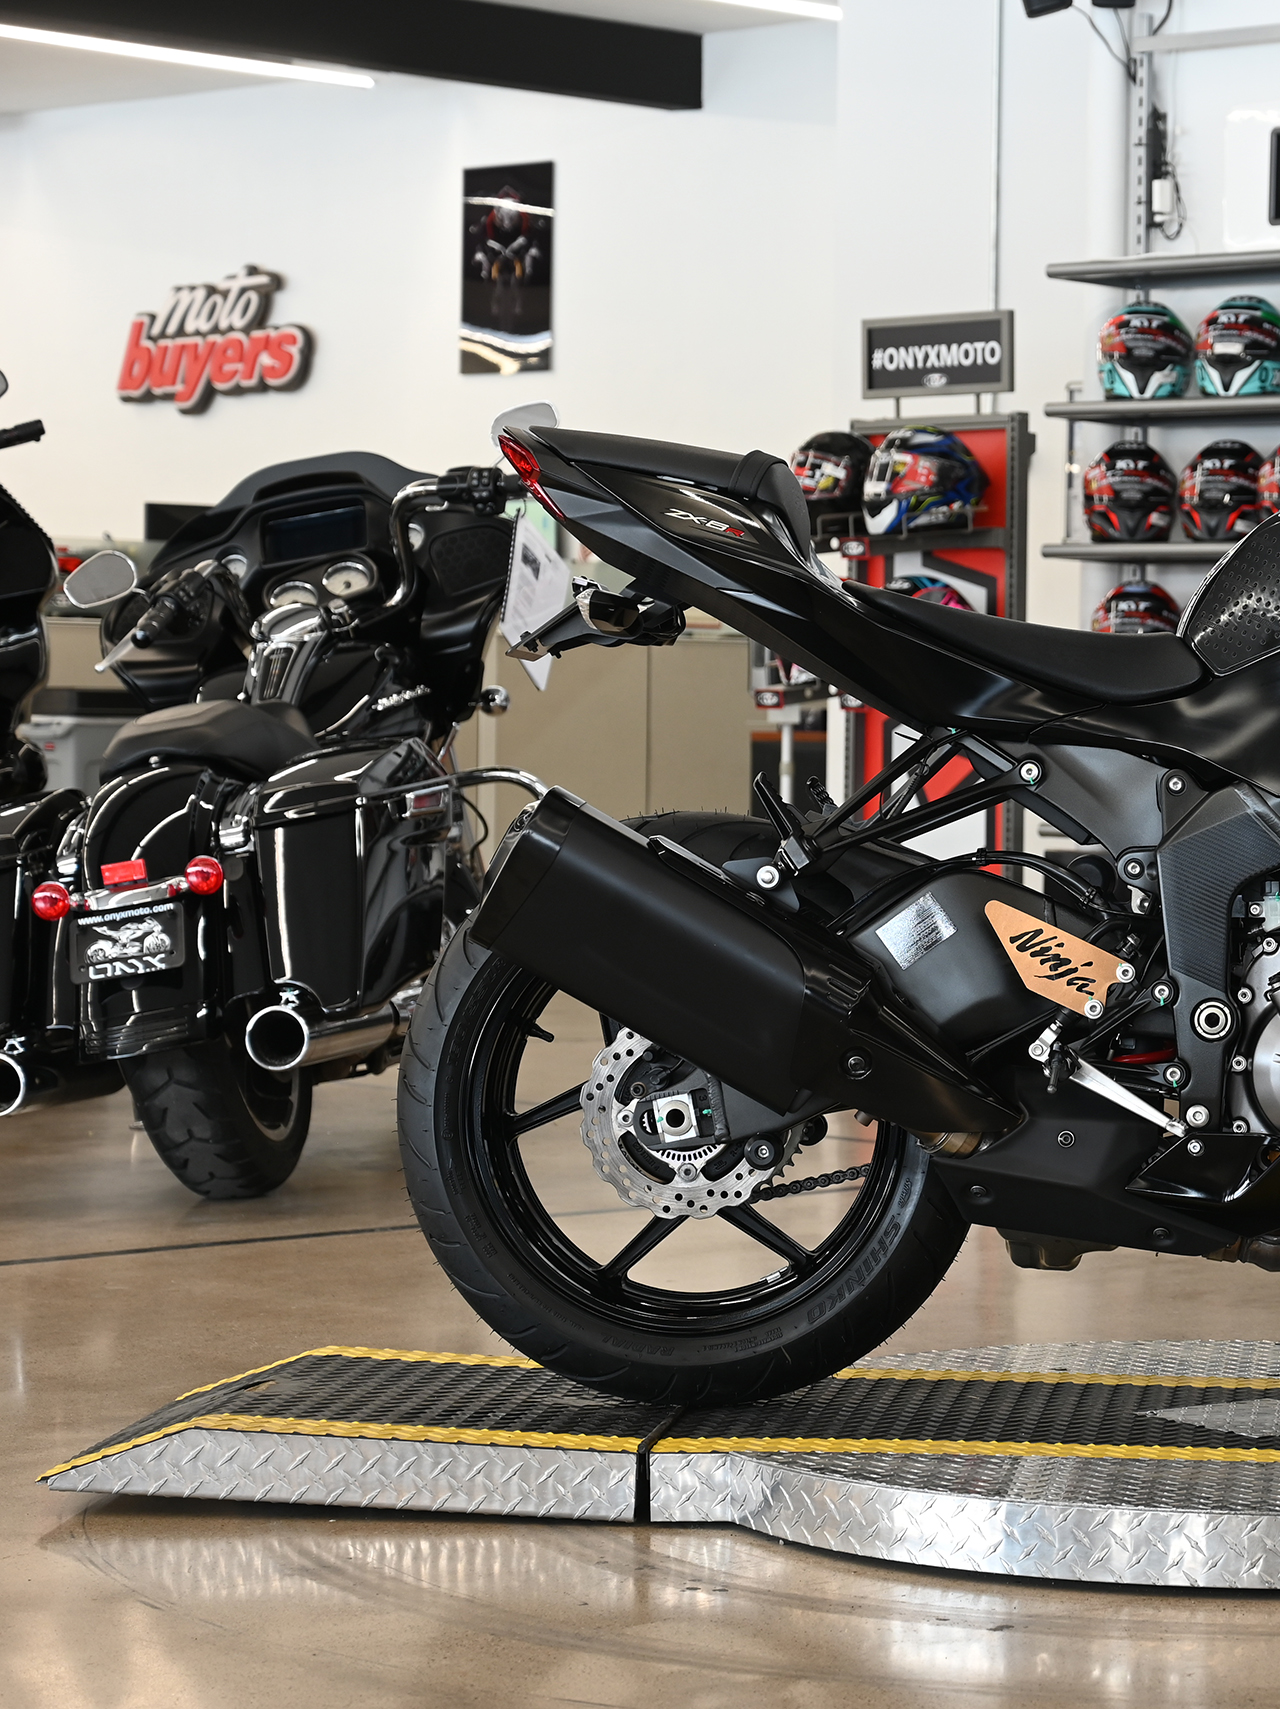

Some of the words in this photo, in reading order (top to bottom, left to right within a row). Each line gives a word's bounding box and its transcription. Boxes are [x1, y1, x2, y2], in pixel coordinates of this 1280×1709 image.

[117, 319, 299, 405] buyers
[871, 340, 1002, 372] #ONYXMOTO
[663, 508, 745, 538] ZX-6R
[77, 903, 174, 926] www.onyxmoto.com
[88, 953, 167, 980] ONYX
[1009, 928, 1097, 997] Ninja
[806, 1214, 902, 1324] SHINKO
